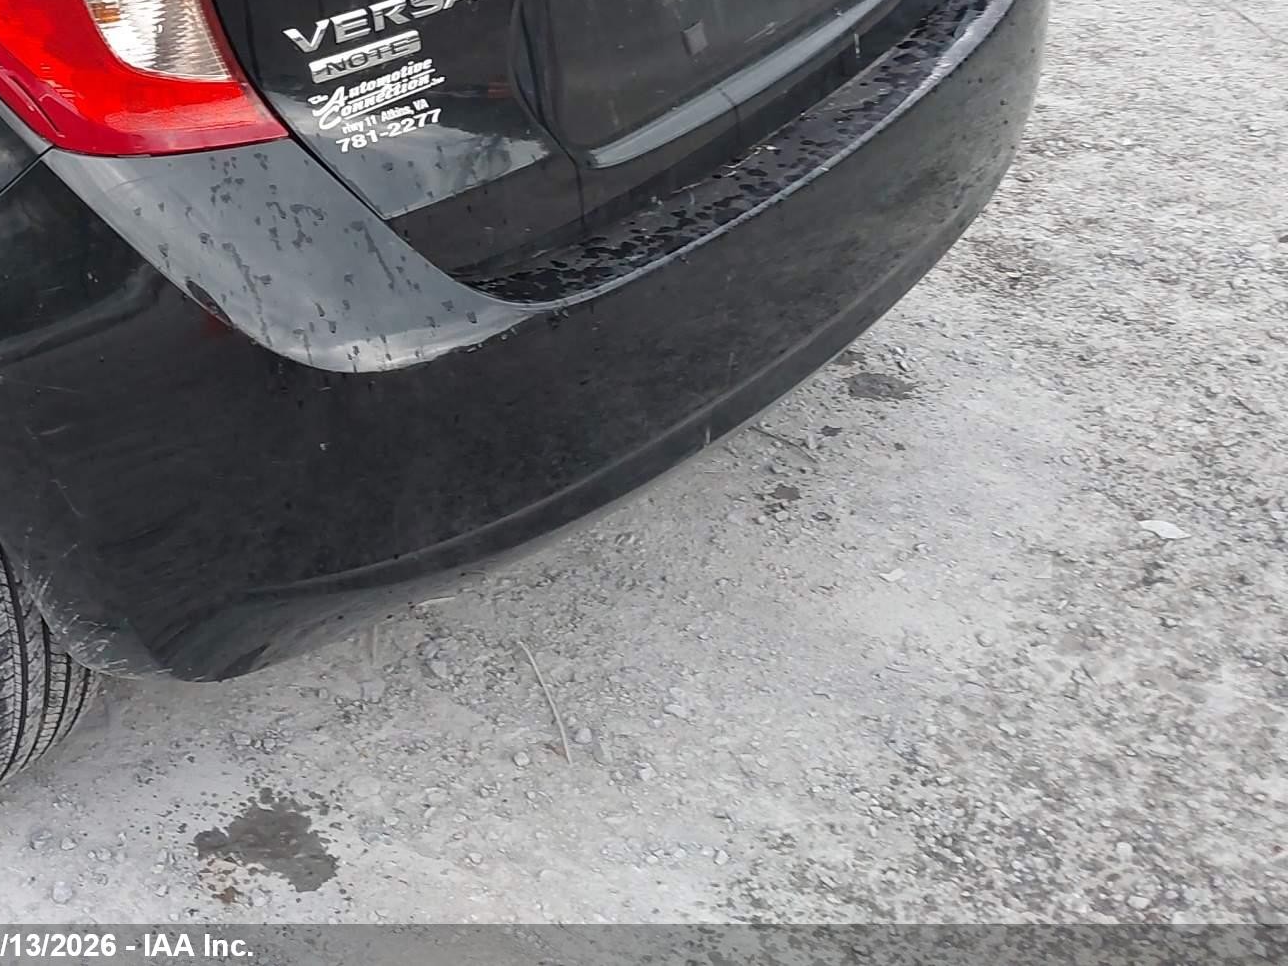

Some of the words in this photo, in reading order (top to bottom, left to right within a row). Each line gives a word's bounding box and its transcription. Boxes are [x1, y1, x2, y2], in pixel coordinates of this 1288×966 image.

[324, 36, 421, 75] NOTE
[312, 58, 433, 117] Automotive
[319, 74, 431, 130] Connection
[413, 98, 429, 111] VA
[336, 108, 442, 152] 781-2277
